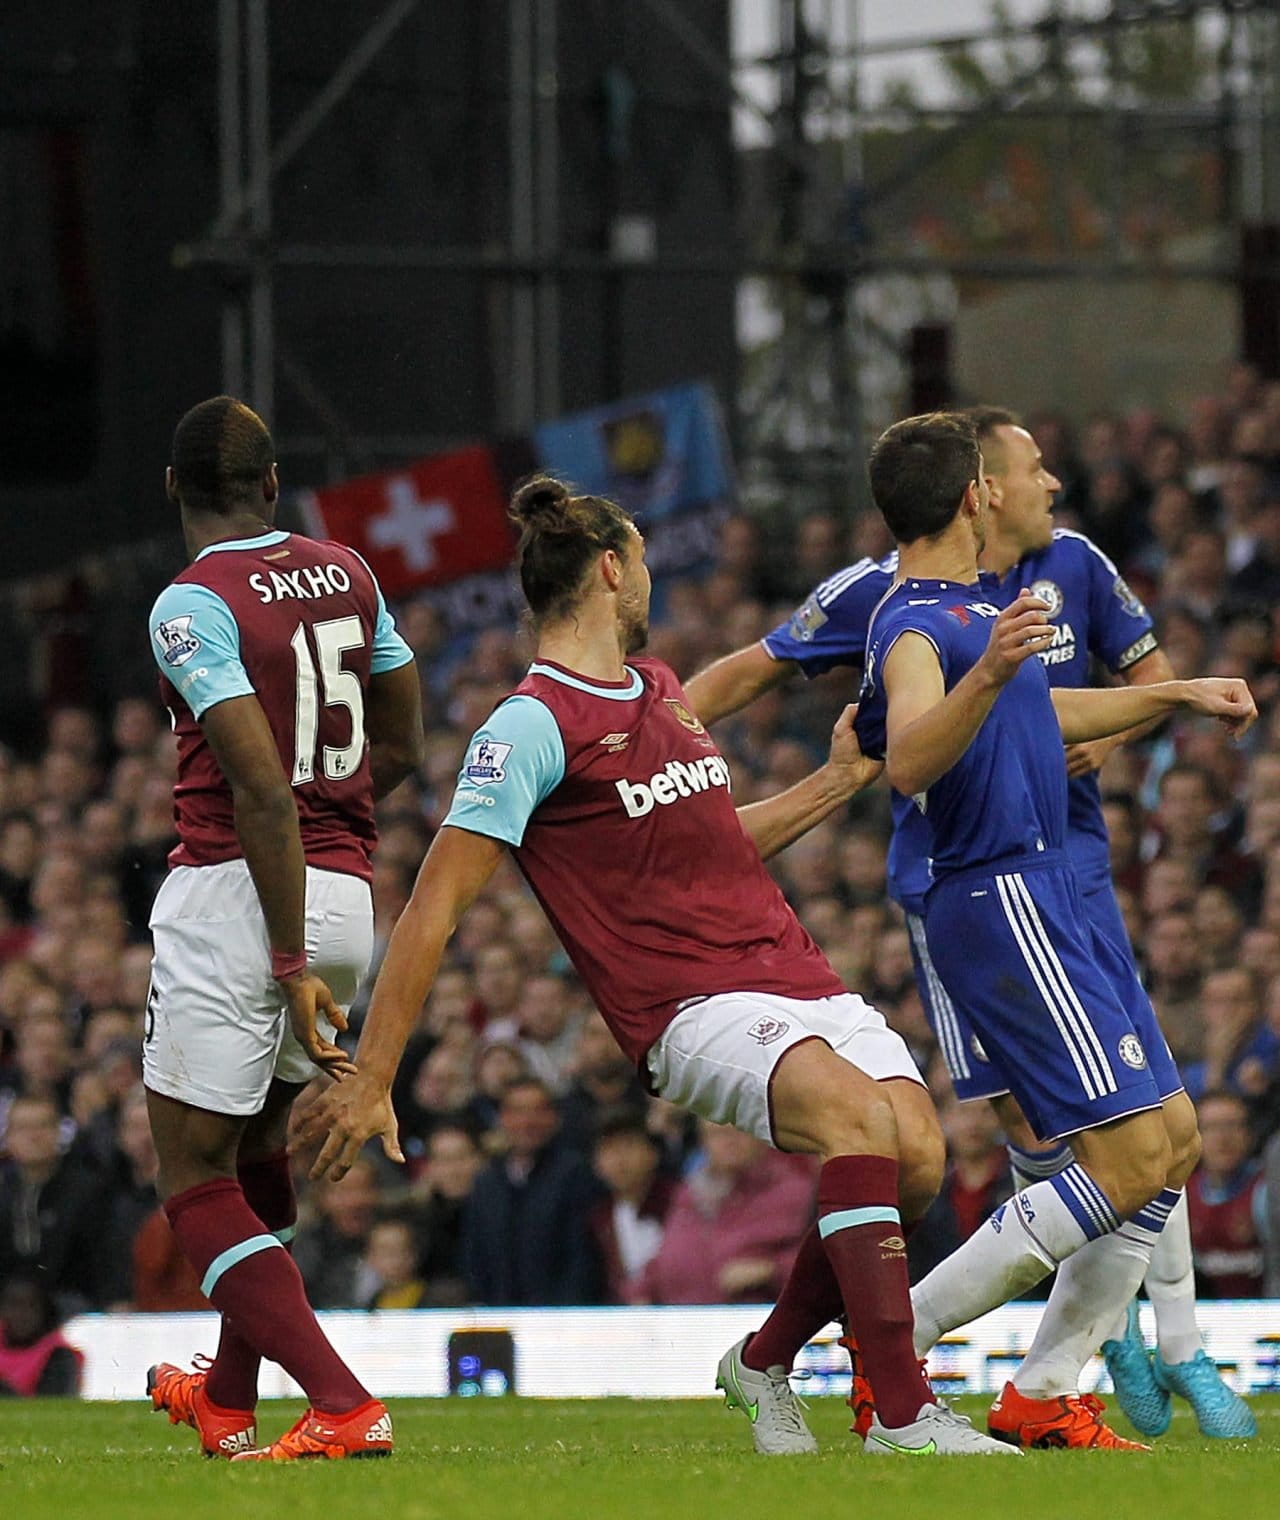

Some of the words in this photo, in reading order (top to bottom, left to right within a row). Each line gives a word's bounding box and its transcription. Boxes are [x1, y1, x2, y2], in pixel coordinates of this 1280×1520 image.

[249, 564, 350, 604] SAKHO
[290, 615, 365, 786] 15
[615, 755, 732, 818] betway
[1019, 1193, 1036, 1223] SEA
